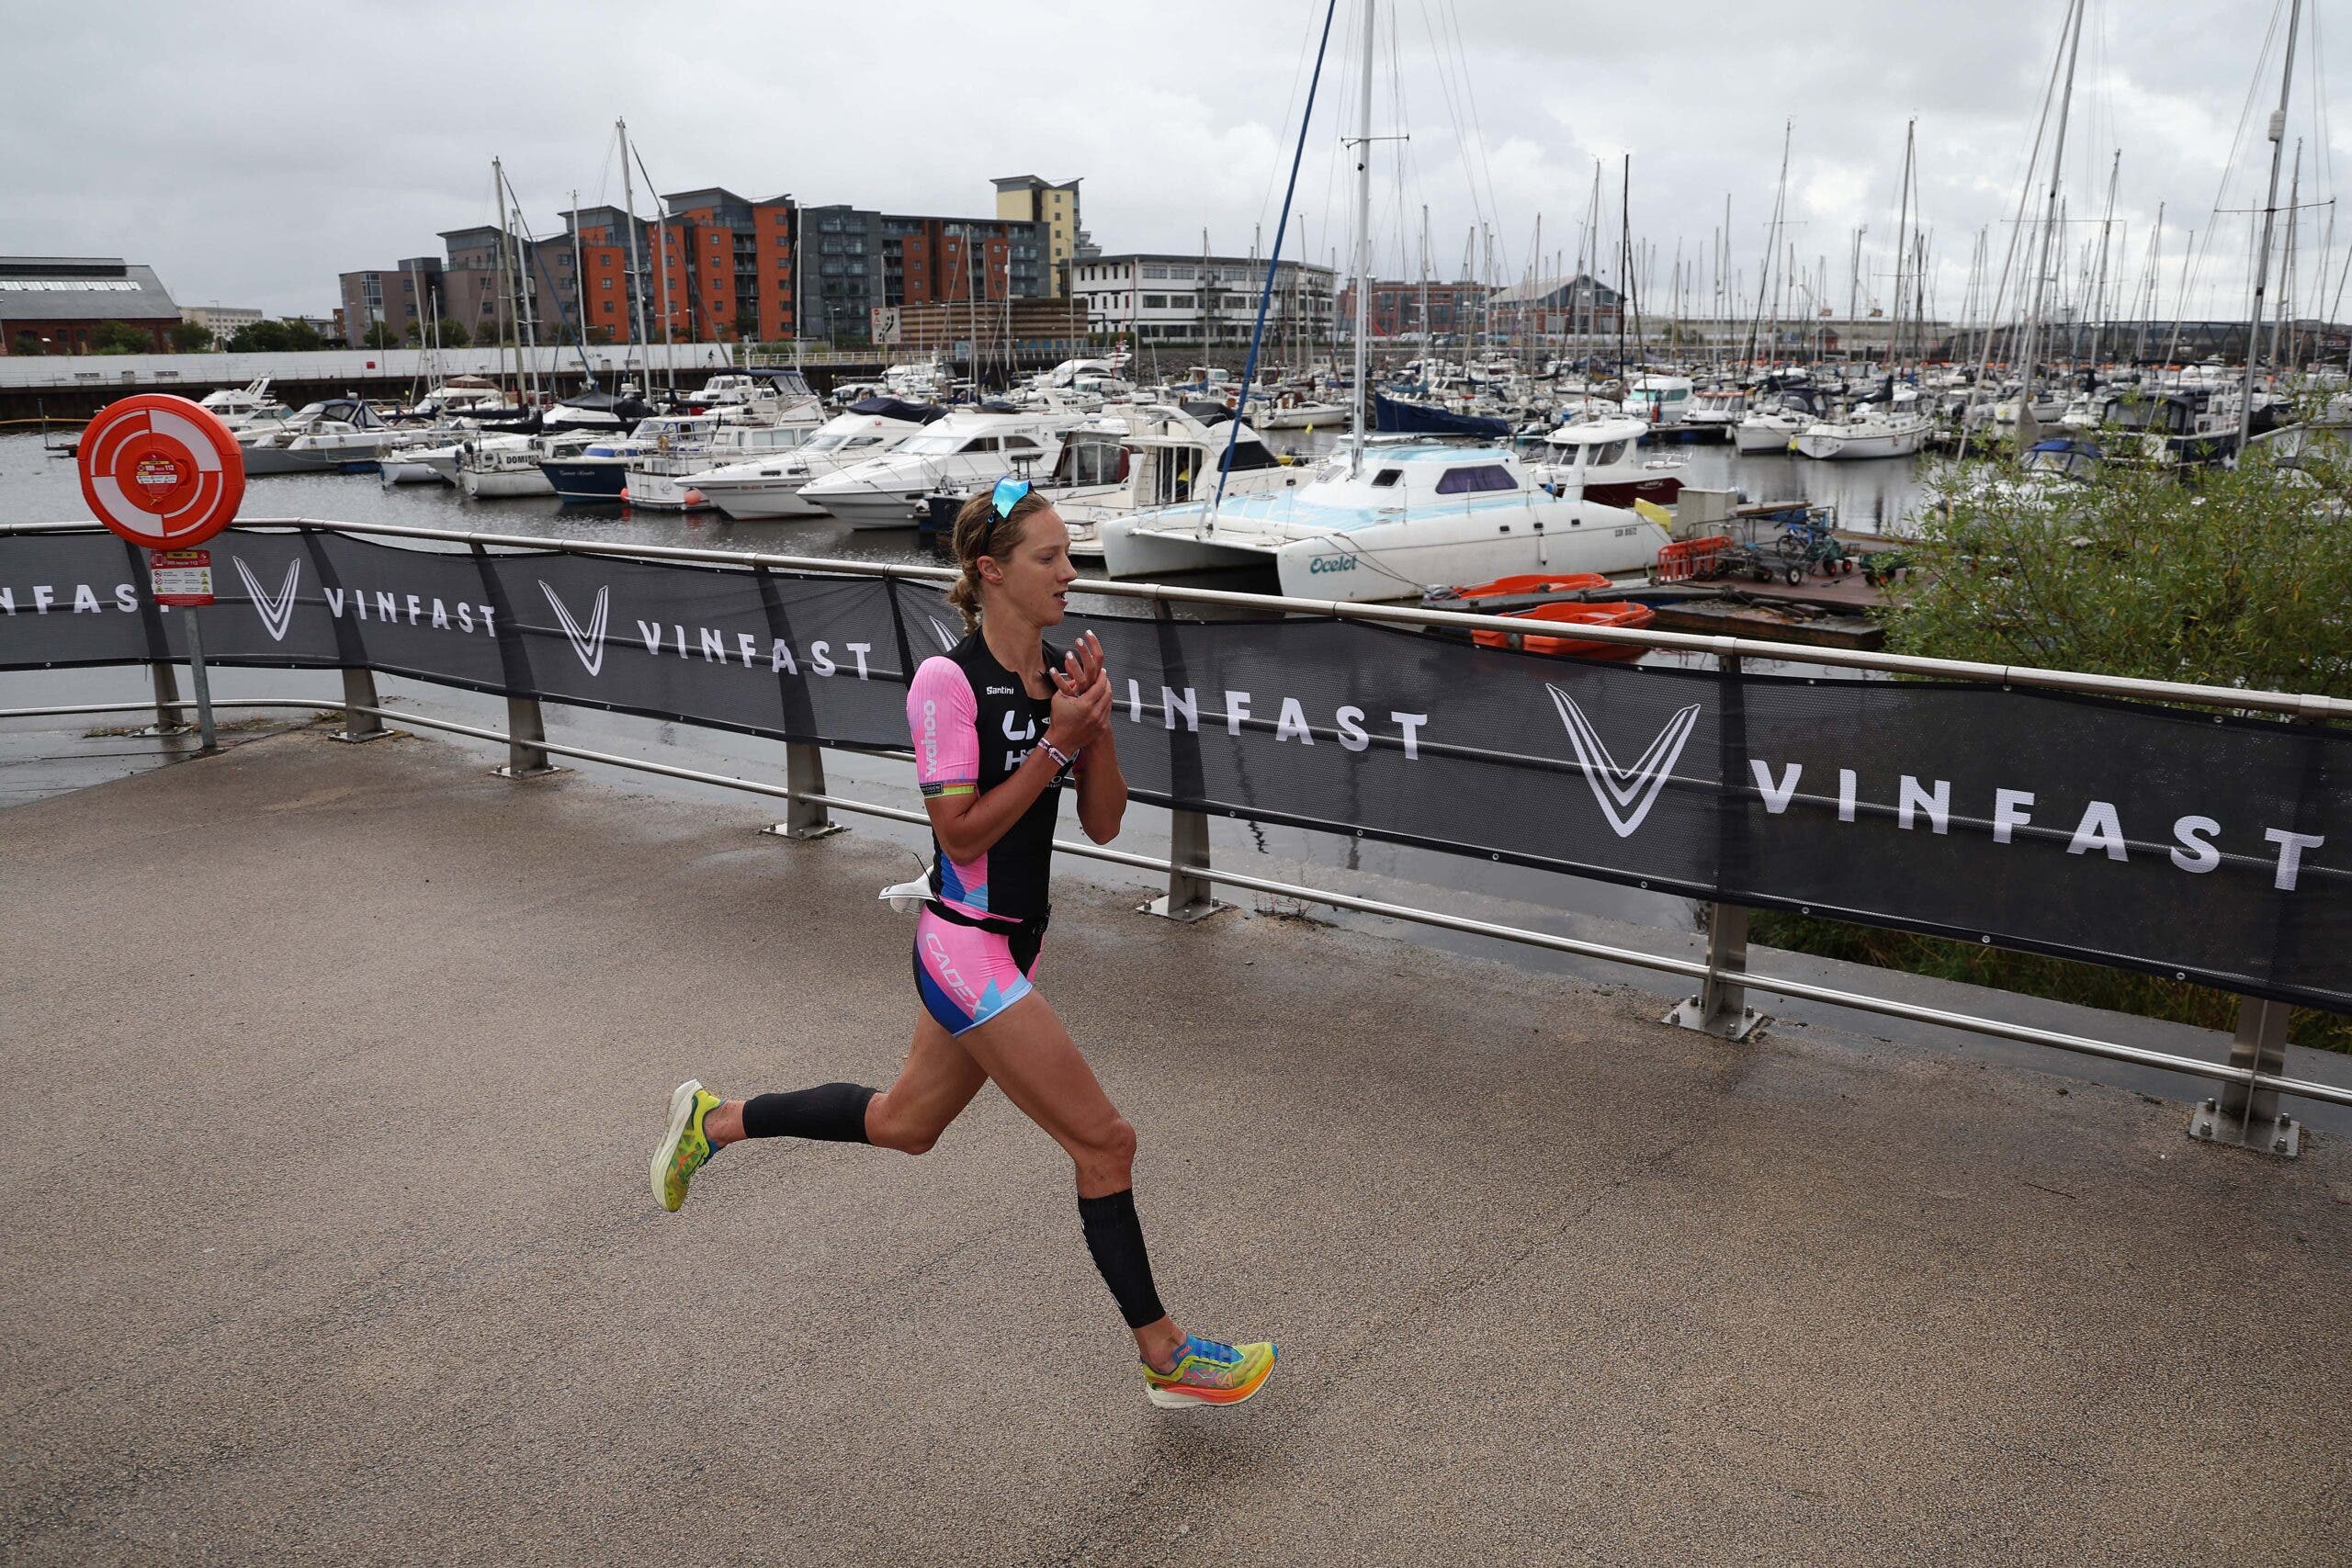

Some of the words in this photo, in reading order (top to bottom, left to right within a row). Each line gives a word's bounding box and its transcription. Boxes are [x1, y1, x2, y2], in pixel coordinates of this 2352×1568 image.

[1310, 554, 1358, 575] Ocelot
[323, 587, 496, 637] VINFAST
[637, 619, 872, 681] VINFAST
[986, 685, 1014, 695] Santini
[1127, 678, 1428, 761] INFAST
[921, 700, 938, 779] wahoo
[1748, 759, 2325, 892] VINFAST
[925, 932, 989, 1016] CADEX
[1182, 1366, 1235, 1389] HOKA
